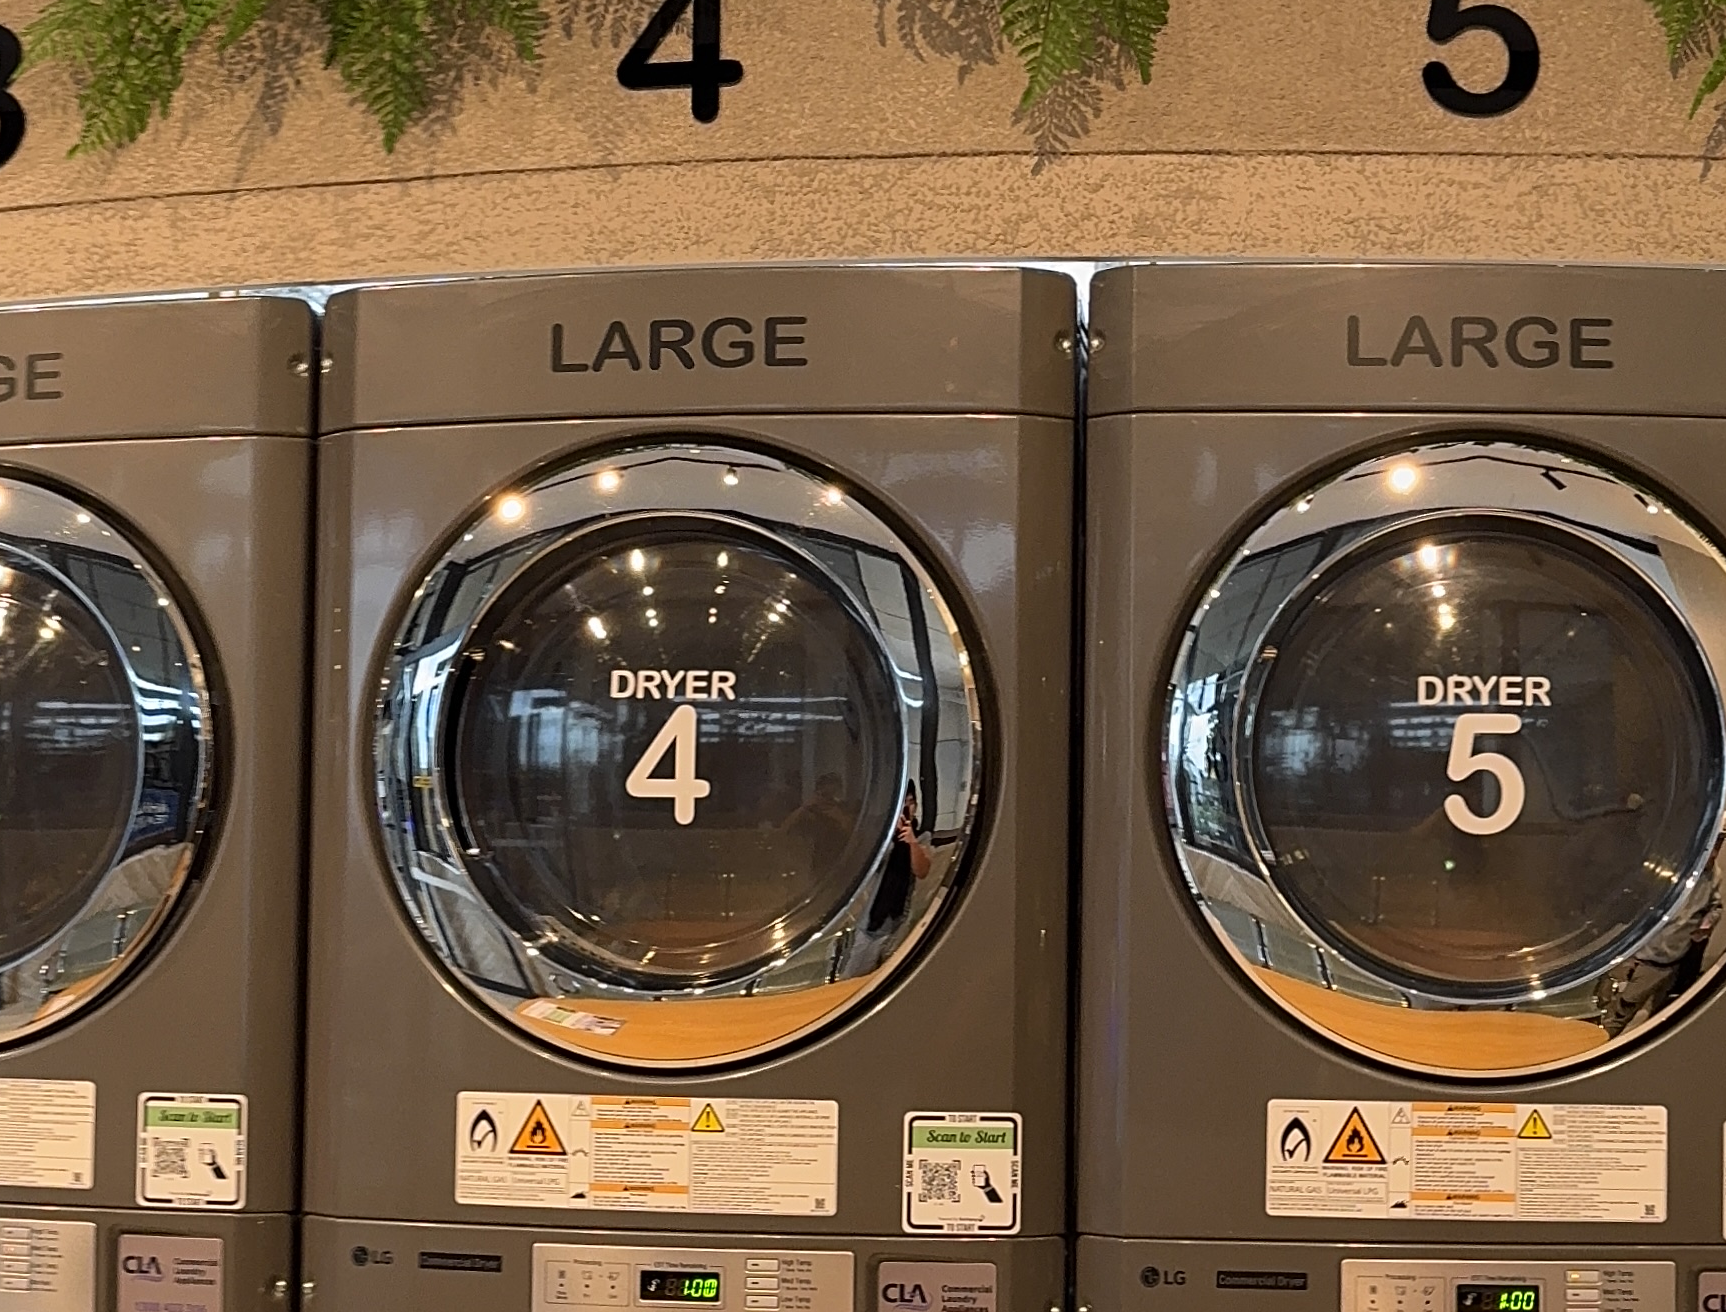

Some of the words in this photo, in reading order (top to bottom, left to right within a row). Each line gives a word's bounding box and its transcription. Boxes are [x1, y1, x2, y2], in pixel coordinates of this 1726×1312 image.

[549, 316, 808, 374] LARGE
[1346, 315, 1615, 370] LARGE
[609, 669, 736, 702] DRYER
[1416, 675, 1552, 708] DRYER
[624, 705, 711, 826] 4
[1443, 714, 1527, 835] 5
[926, 1130, 957, 1143] Scan
[959, 1132, 971, 1143] to
[975, 1130, 1006, 1143] Start
[122, 1255, 161, 1274] CLA
[1164, 1270, 1186, 1285] LG
[882, 1283, 927, 1303] CLA
